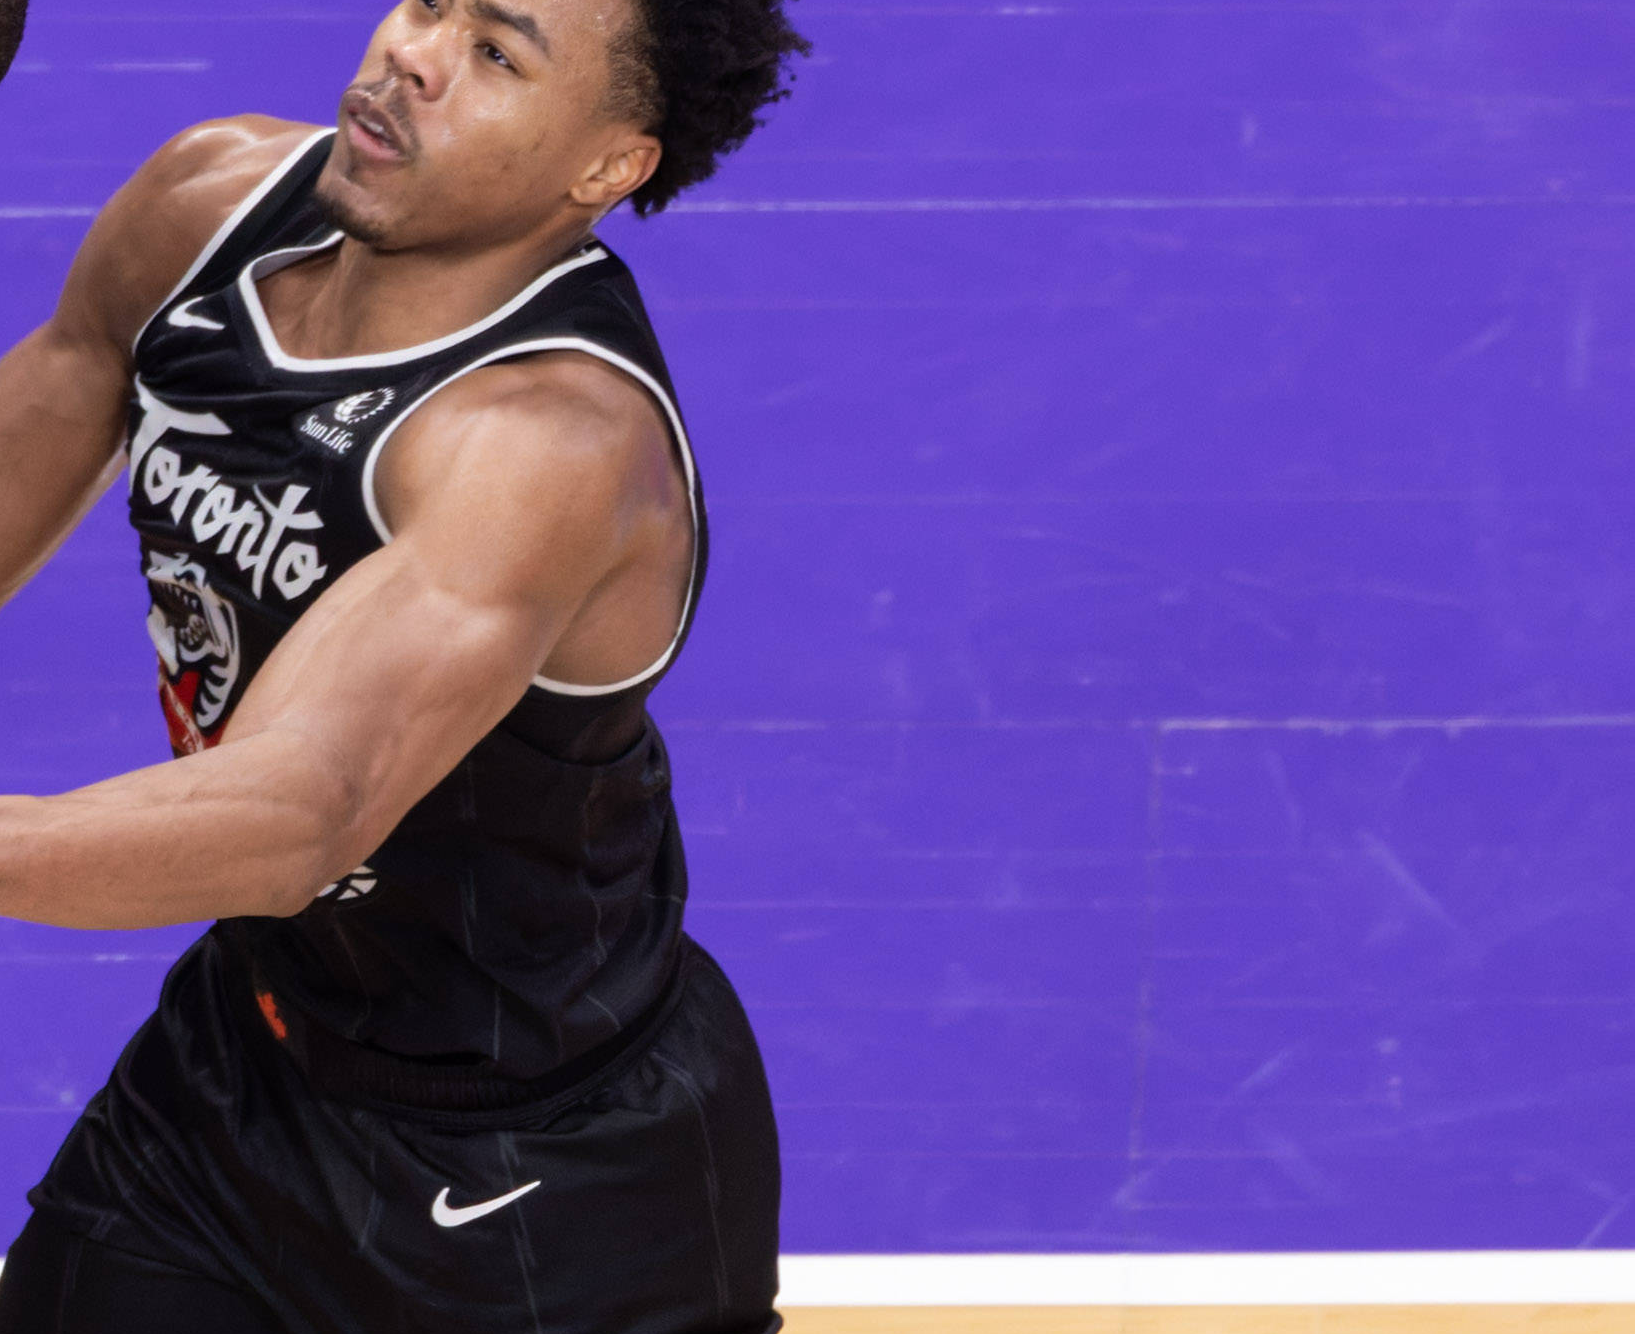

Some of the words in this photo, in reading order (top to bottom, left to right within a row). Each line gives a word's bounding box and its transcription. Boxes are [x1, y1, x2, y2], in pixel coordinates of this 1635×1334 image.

[129, 371, 328, 601] Toronto
[299, 414, 328, 439] Sun
[321, 426, 353, 455] Life
